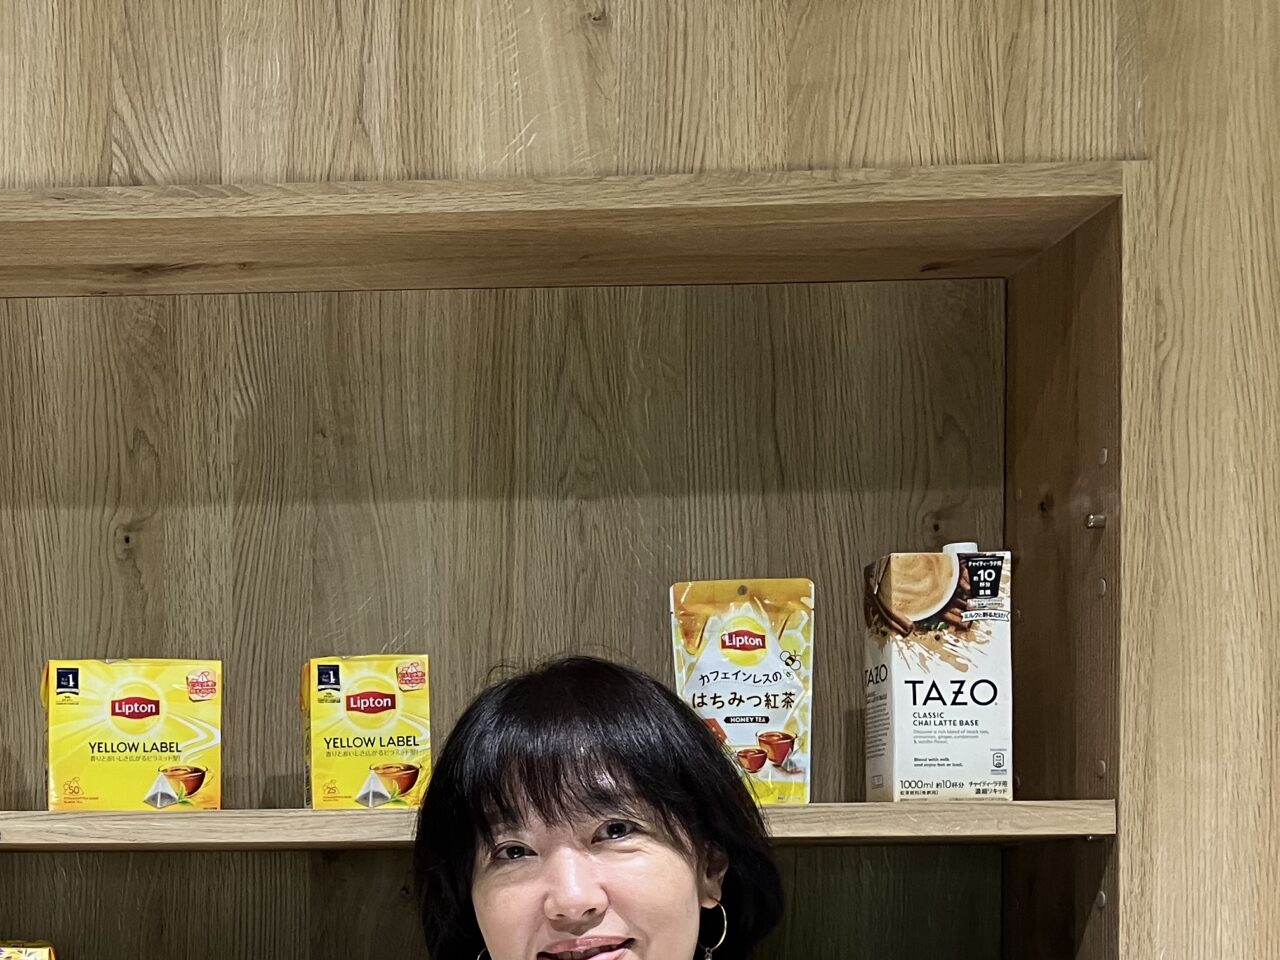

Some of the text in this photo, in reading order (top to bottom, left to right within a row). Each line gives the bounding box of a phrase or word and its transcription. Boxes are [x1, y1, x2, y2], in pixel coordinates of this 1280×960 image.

[724, 633, 763, 647] Lipton
[699, 669, 782, 687] カフェインレスの
[904, 679, 998, 706] TAZO
[350, 697, 391, 710] Lipton
[692, 692, 796, 710] はちみつ紅茶
[114, 702, 156, 715] Lipton
[730, 716, 754, 724] HONEY
[89, 742, 182, 754] YELLOW LABEL
[324, 735, 419, 750] YELLOW LABEL
[69, 786, 80, 795] 50
[326, 786, 336, 794] 25
[900, 780, 934, 789] 1000ml
